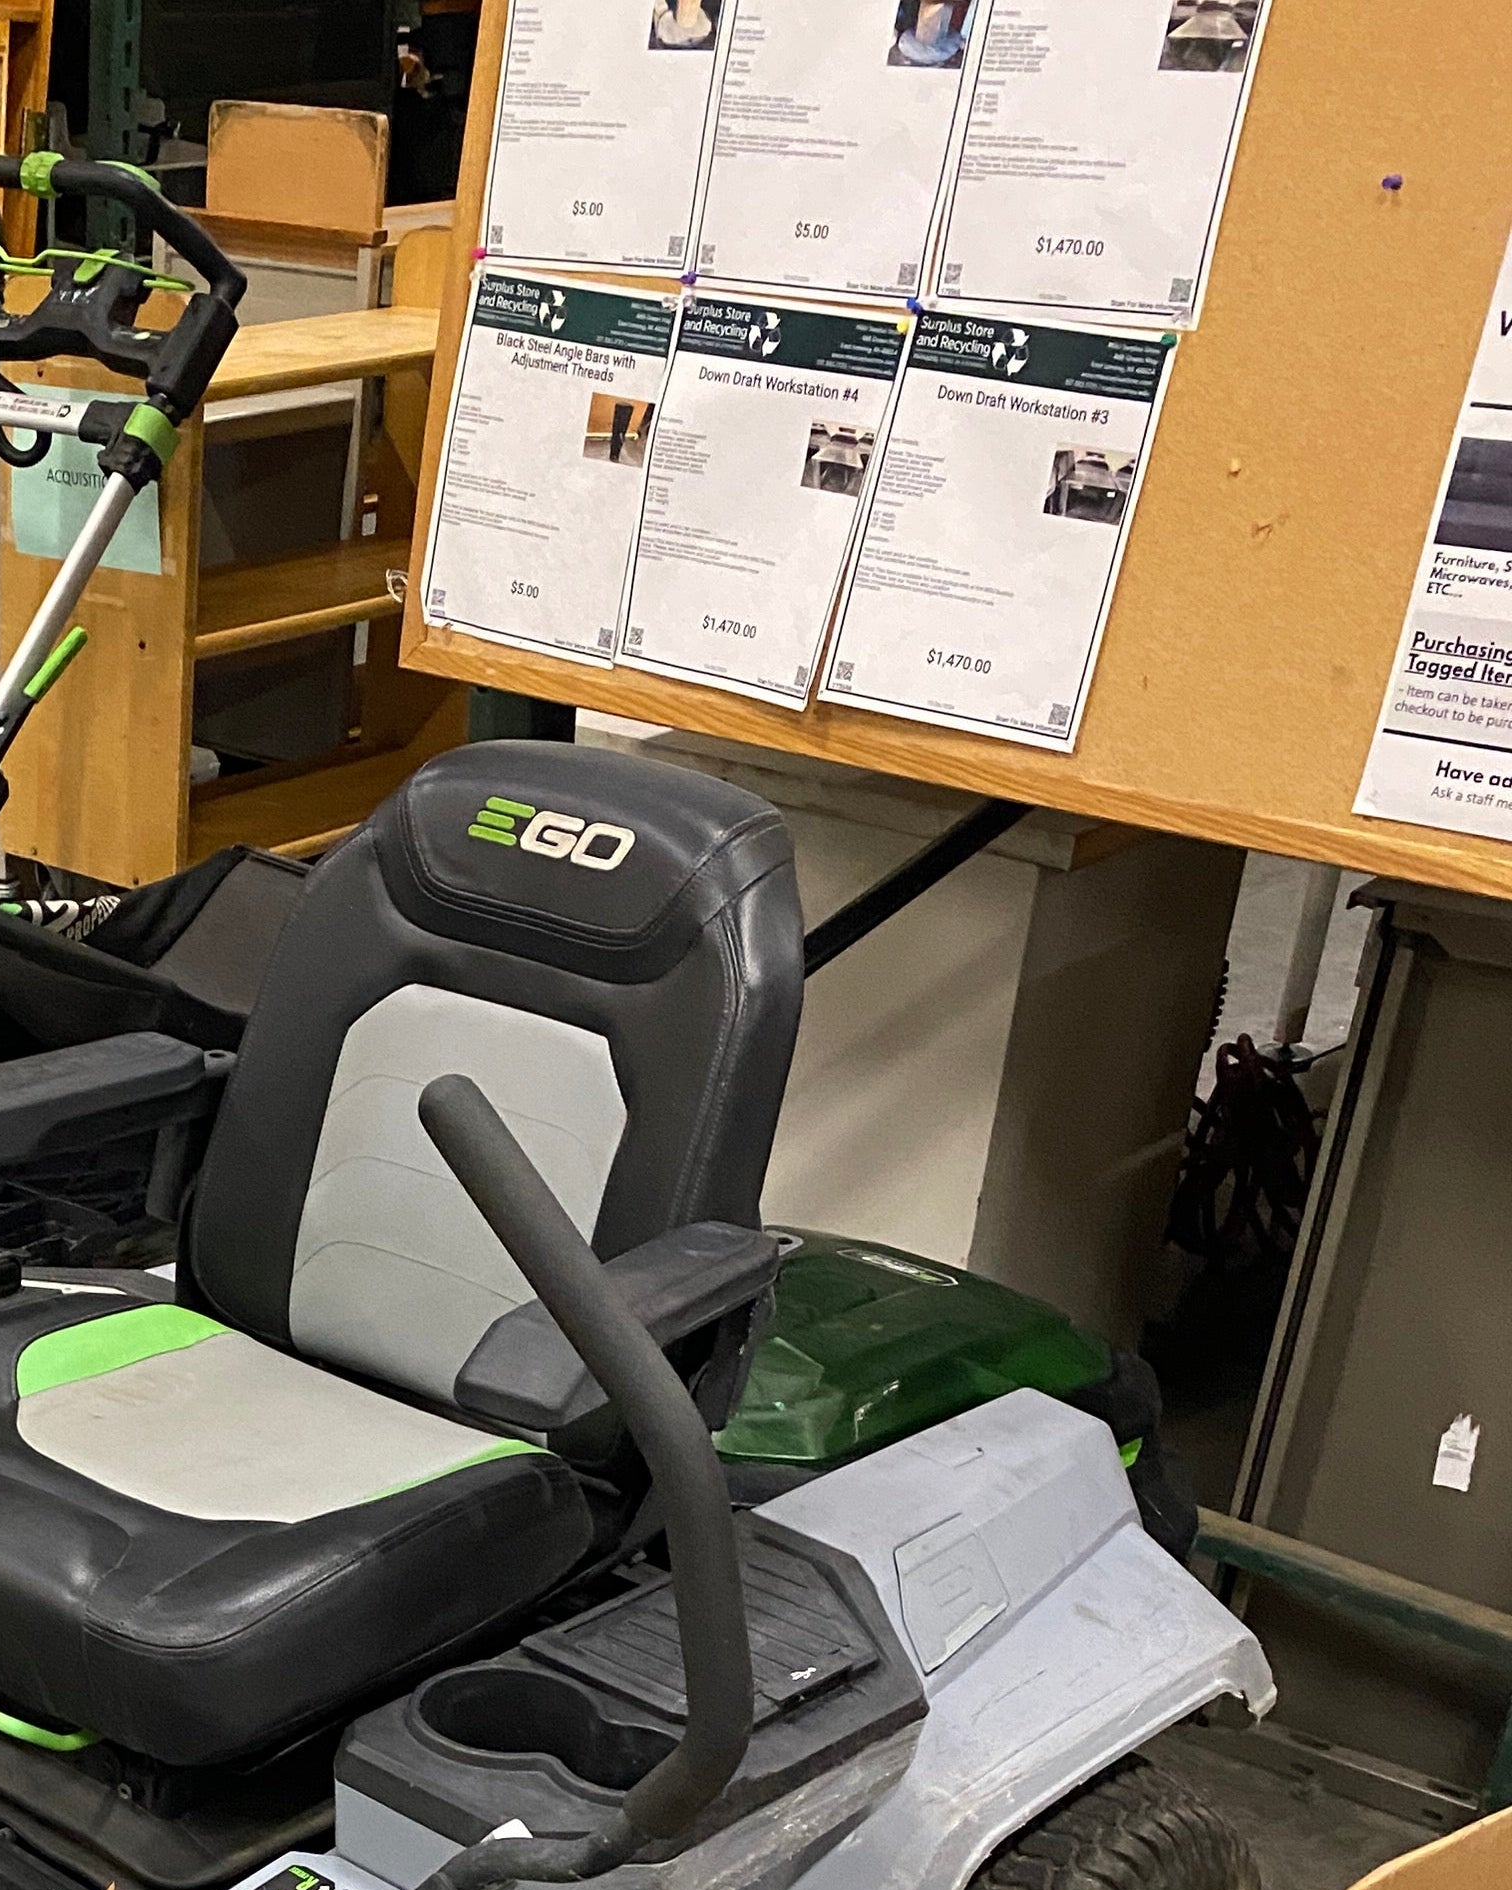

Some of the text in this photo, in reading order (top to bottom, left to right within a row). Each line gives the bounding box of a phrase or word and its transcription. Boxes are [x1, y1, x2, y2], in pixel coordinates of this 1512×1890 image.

[571, 200, 604, 216] $5.00
[794, 221, 829, 239] $5.00
[1035, 236, 1104, 257] $1,470.00
[517, 284, 540, 298] Store
[496, 296, 539, 317] Recycling
[725, 307, 751, 322] Store
[683, 318, 748, 340] and Recycling
[920, 316, 995, 338] Surplus Store
[497, 332, 636, 369] Black Steel Angle Bars with
[916, 333, 991, 357] and Recycling
[511, 352, 615, 383] Adjustment Threads
[699, 365, 859, 402] Down Draft Workstation #4
[938, 384, 1109, 425] Down Draft Workstation #3
[1434, 551, 1500, 574] Furniture,
[510, 579, 539, 599] $5.00
[702, 614, 757, 639] $1,470.00
[926, 648, 992, 674] $1,470.00
[1408, 653, 1478, 681] Tagged
[1407, 685, 1434, 700] Item
[1437, 691, 1459, 702] can
[1462, 692, 1478, 706] be
[1394, 700, 1449, 719] checkout
[1452, 710, 1465, 722] to
[1468, 711, 1484, 724] be
[1435, 760, 1484, 783] Have
[1431, 786, 1454, 799] Ask
[1455, 792, 1463, 801] a
[1465, 793, 1495, 806] staff
[467, 796, 636, 871] EGO
